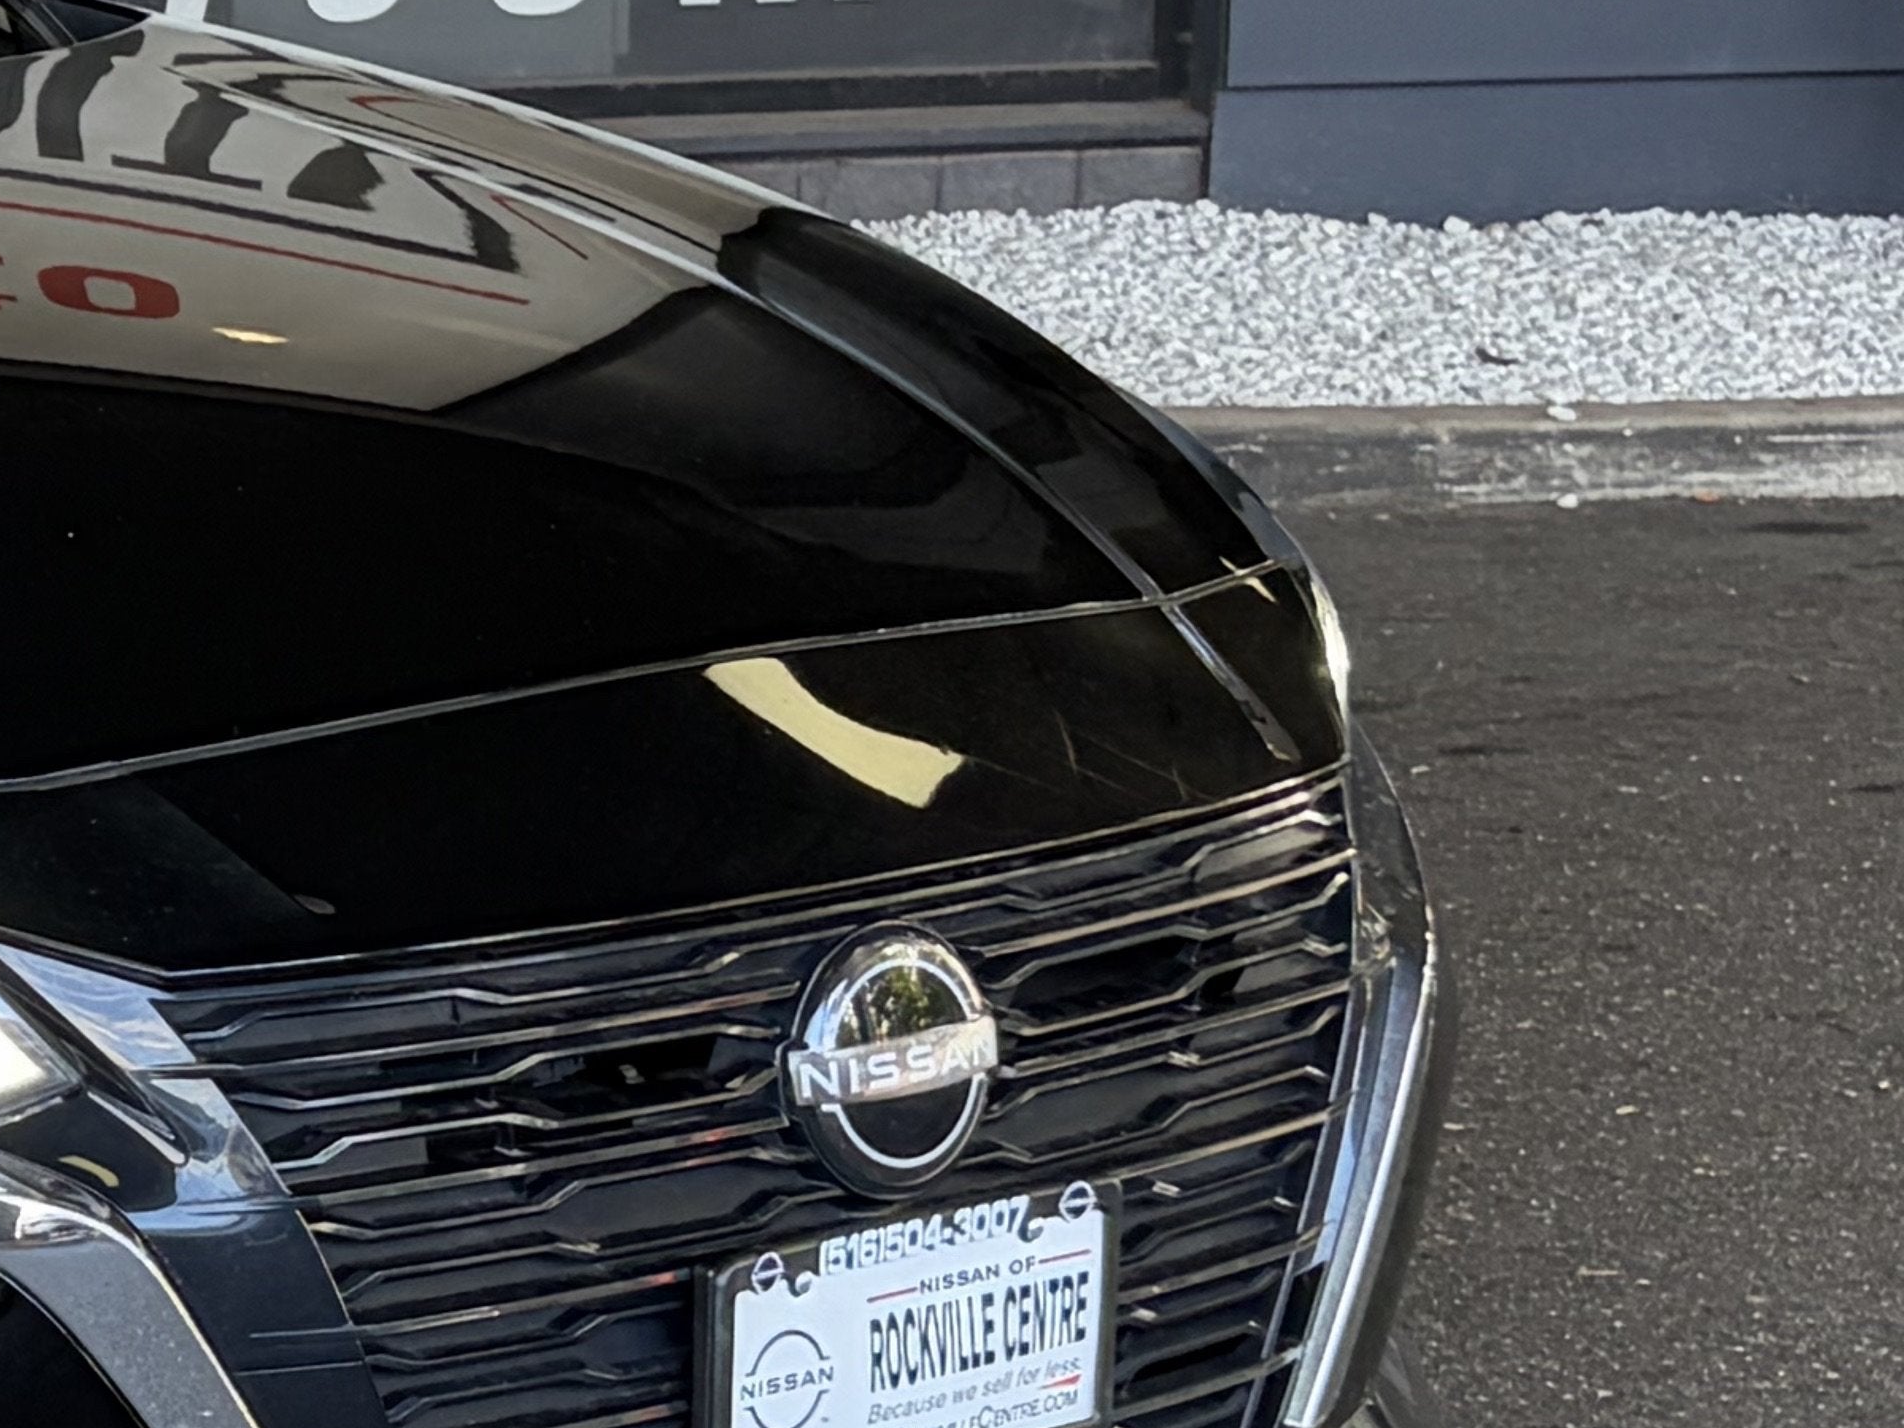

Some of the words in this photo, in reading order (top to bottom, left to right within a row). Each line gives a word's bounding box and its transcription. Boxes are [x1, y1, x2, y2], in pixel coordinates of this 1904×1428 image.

[799, 1033, 993, 1100] NISSAN
[919, 1263, 1001, 1294] NISSAN
[1008, 1255, 1036, 1275] OF
[870, 1292, 996, 1393] ROCKVILLE
[1003, 1271, 1090, 1362] CENTRE
[740, 1365, 834, 1401] NISSAN
[868, 1392, 948, 1424] Because
[952, 1384, 978, 1404] we
[981, 1369, 1014, 1396] sell
[1016, 1366, 1042, 1388] for
